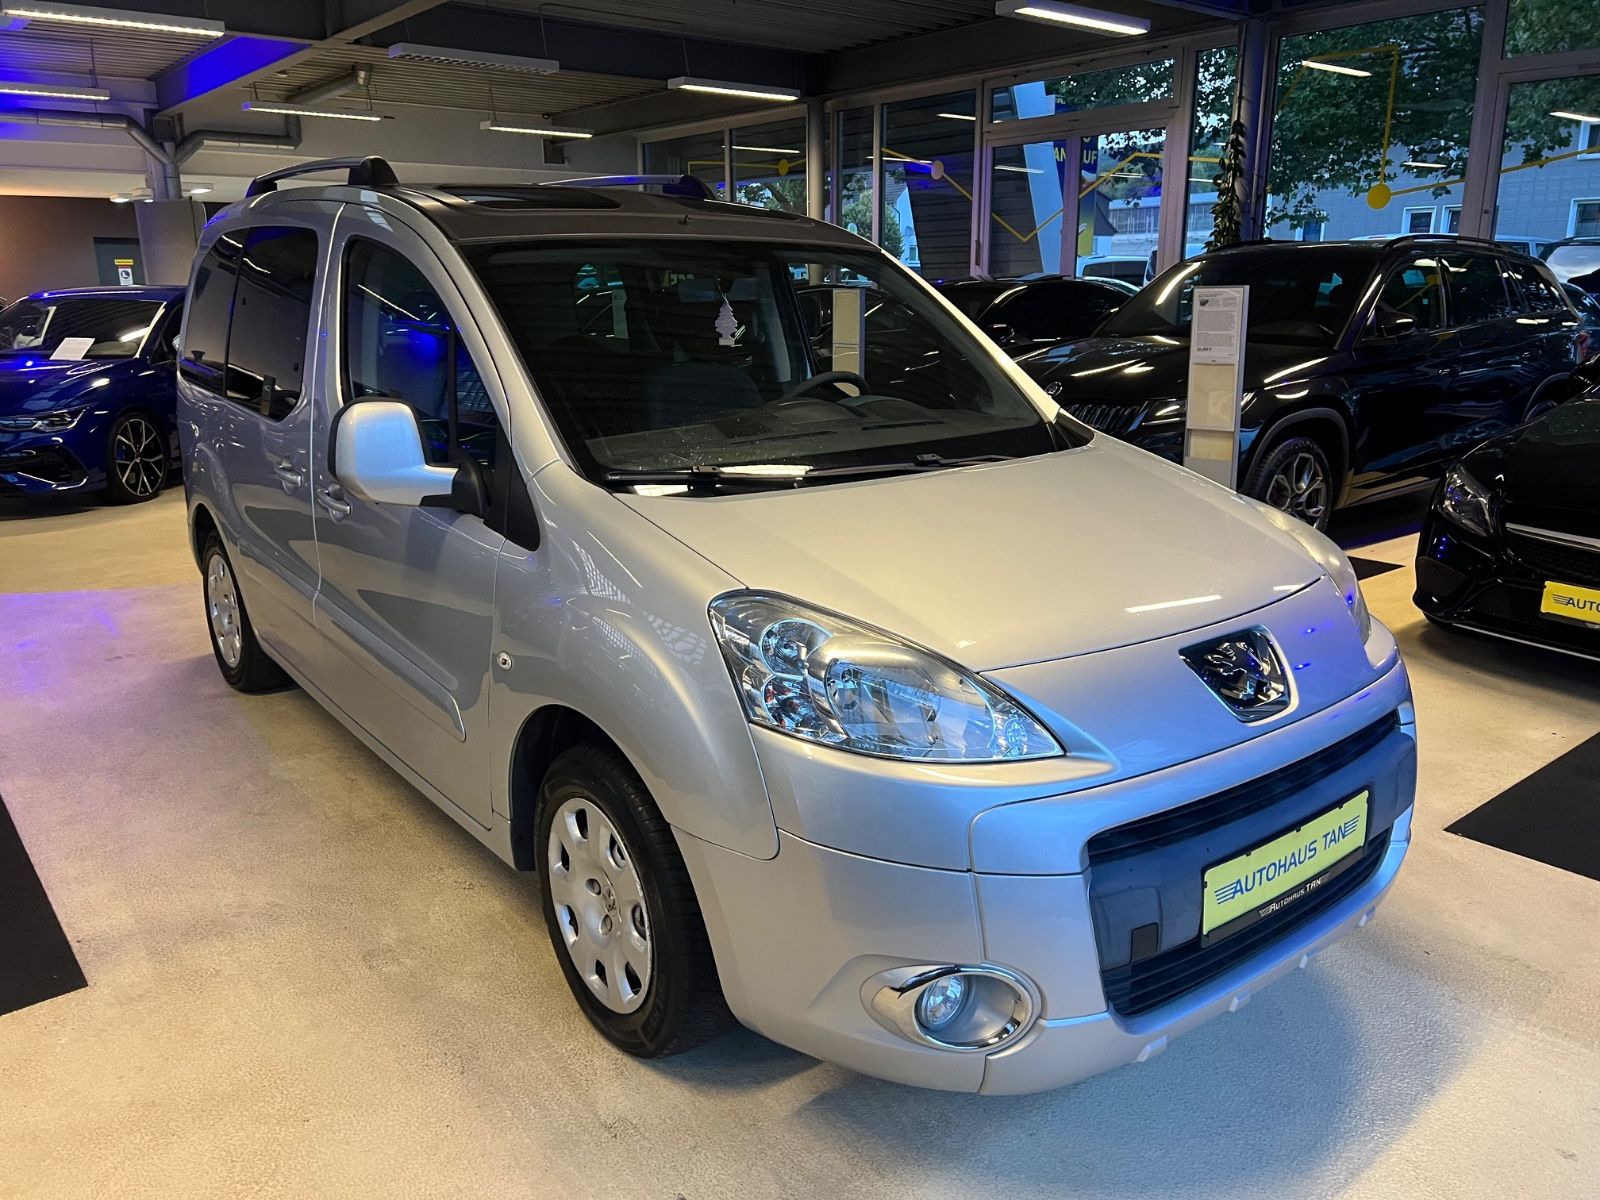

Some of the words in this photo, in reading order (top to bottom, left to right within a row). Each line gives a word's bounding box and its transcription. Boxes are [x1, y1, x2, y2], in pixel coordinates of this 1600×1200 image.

[1231, 839, 1317, 900] AUTOHAUS
[1322, 822, 1348, 850] TAN
[1306, 877, 1321, 891] TAN
